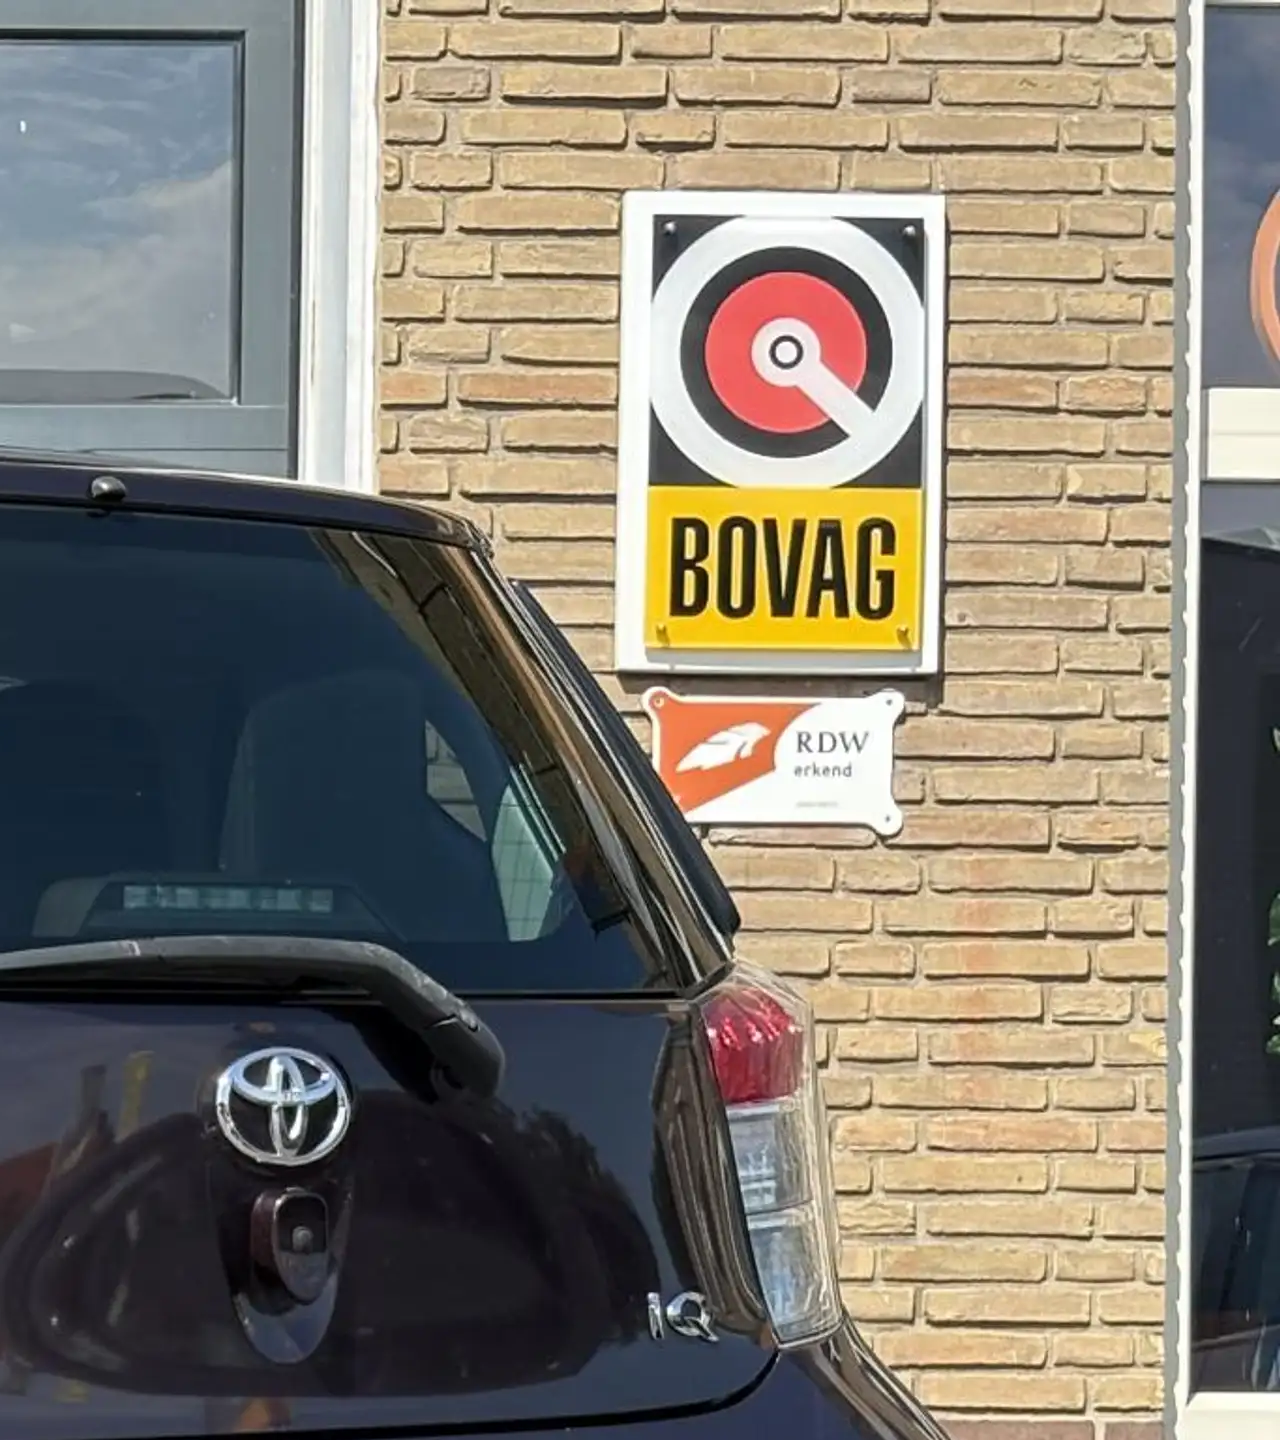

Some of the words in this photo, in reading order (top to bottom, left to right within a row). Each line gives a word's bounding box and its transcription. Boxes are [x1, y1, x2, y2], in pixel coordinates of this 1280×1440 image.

[668, 515, 898, 622] BOVAG
[795, 730, 870, 754] RDW
[793, 760, 853, 778] erkend
